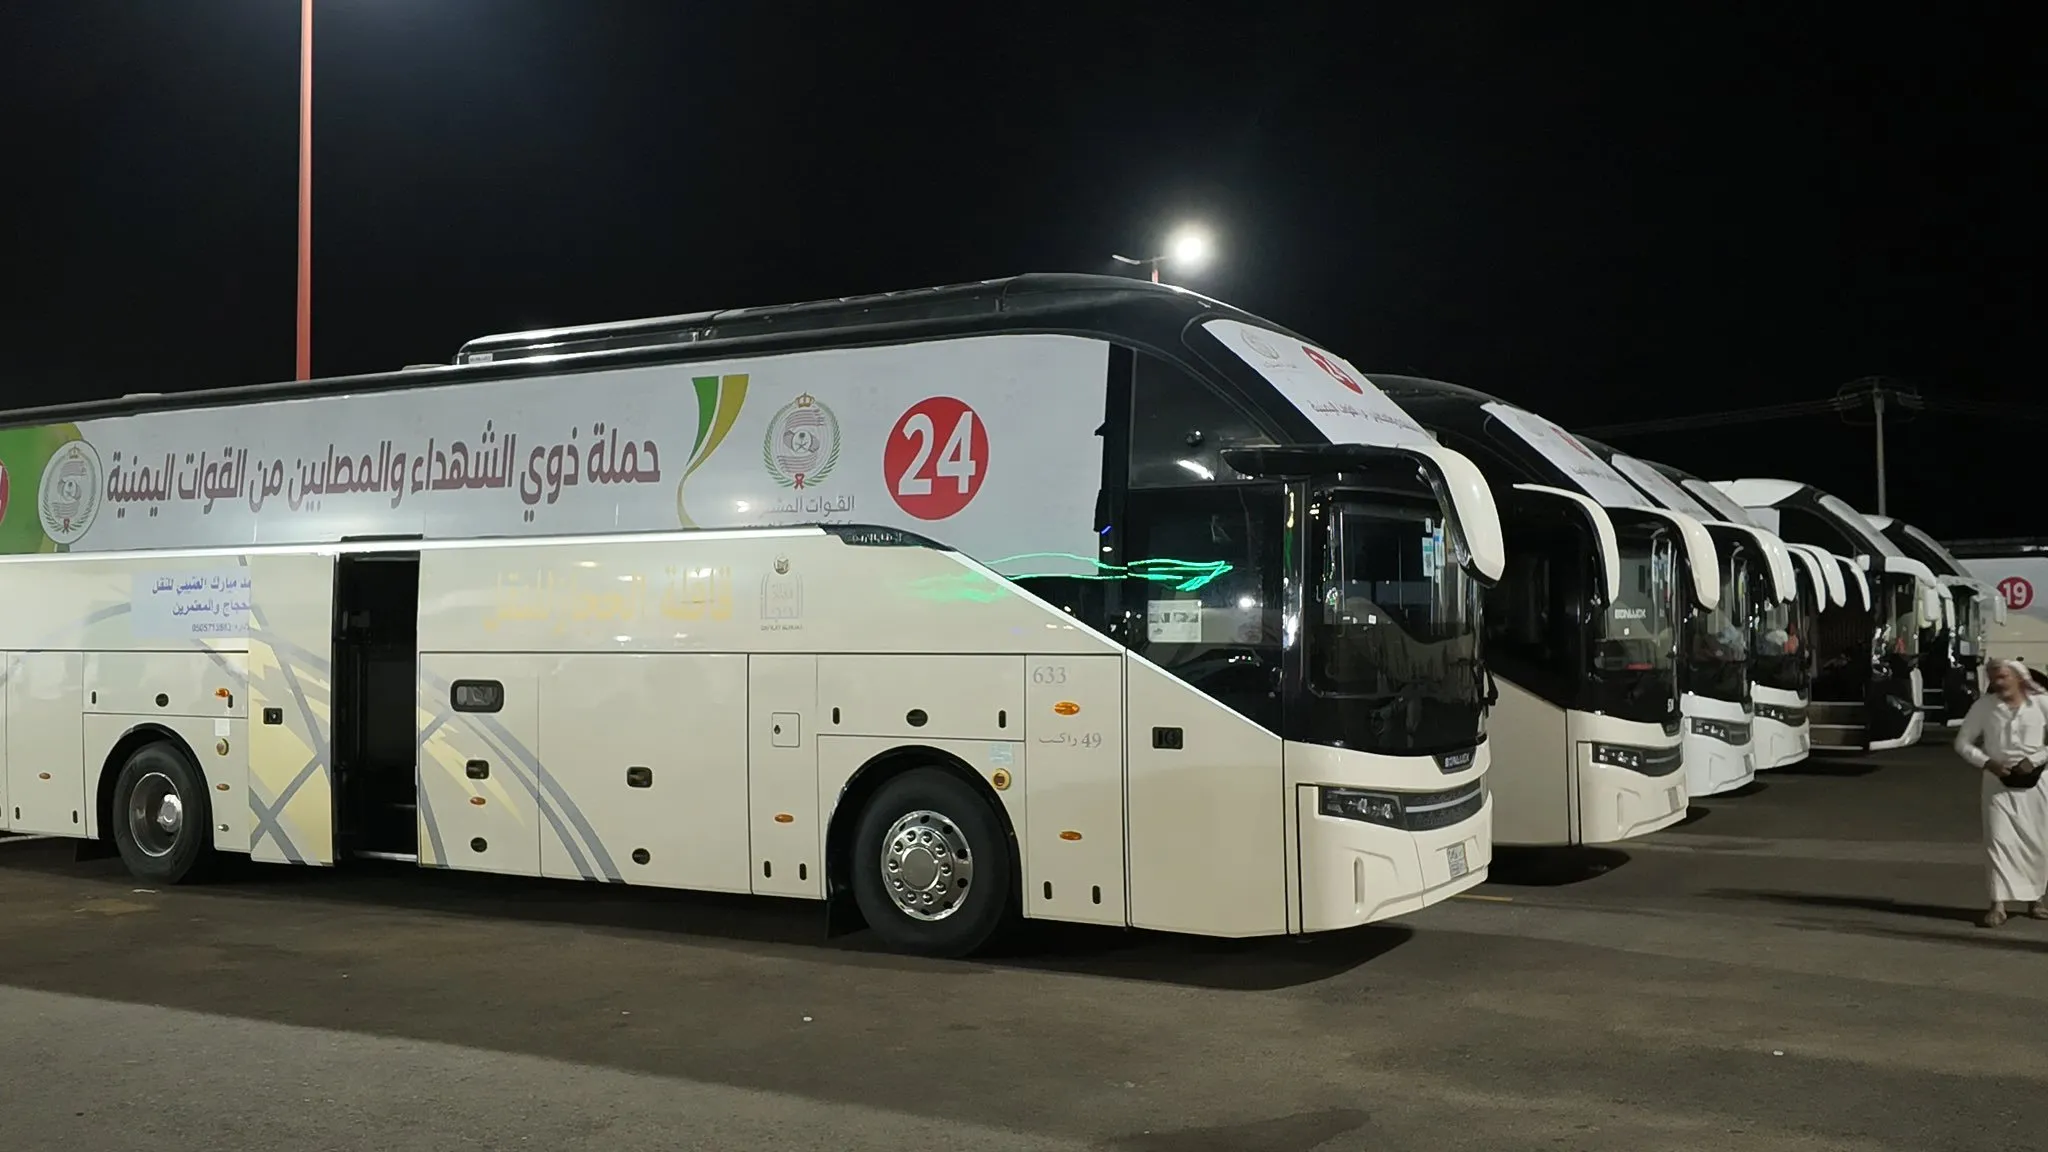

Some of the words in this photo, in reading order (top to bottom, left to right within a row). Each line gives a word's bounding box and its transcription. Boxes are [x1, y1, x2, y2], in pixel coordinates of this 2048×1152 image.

[177, 447, 248, 515] القوات
[287, 440, 406, 512] والمصابين
[411, 419, 516, 495] الشهداء
[519, 426, 580, 522] ذوي
[587, 422, 661, 484] حملة
[898, 412, 977, 497] 24
[107, 451, 176, 518] اليمنية
[249, 459, 283, 513] من
[806, 495, 855, 517] القوات
[152, 577, 174, 595] للنقل
[210, 577, 237, 593] مبارك
[2003, 581, 2027, 606] 19
[1033, 666, 1067, 684] 633
[1081, 733, 1102, 748] 49
